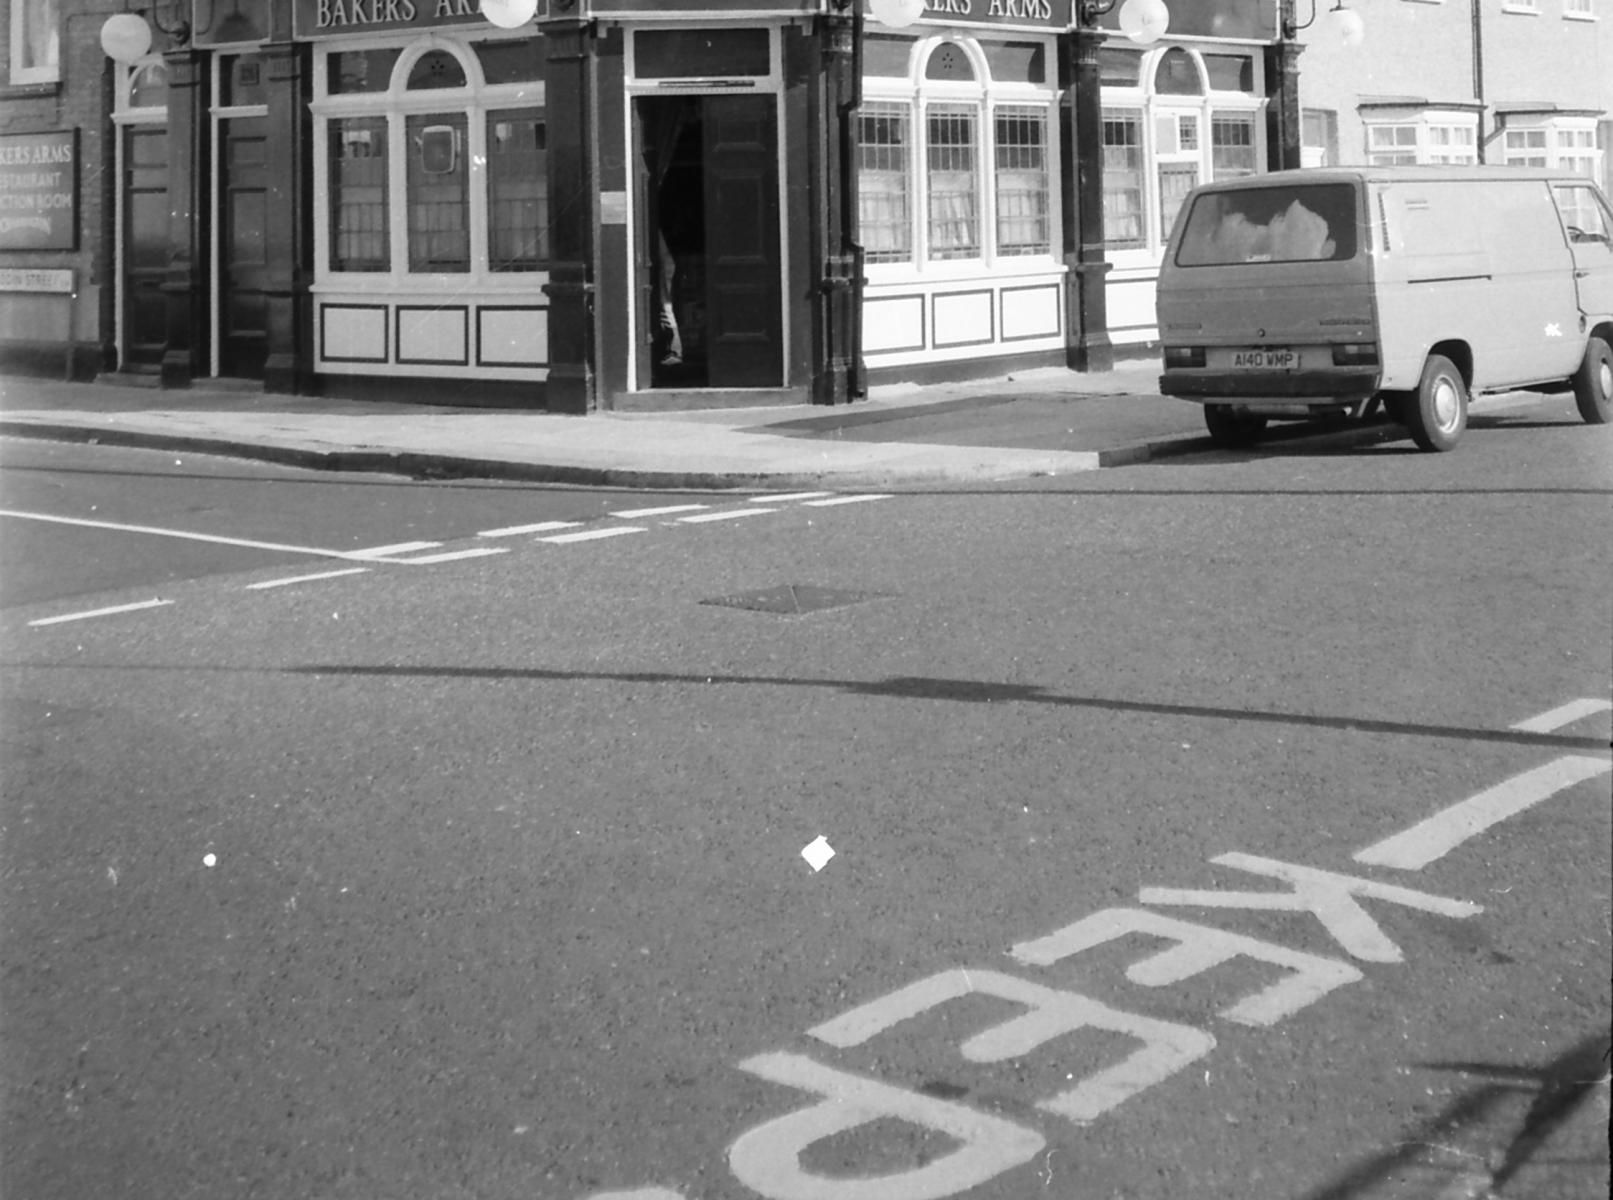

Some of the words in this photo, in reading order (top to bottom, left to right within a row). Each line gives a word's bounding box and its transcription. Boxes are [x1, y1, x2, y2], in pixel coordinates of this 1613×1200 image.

[31, 144, 71, 163] ARMS
[25, 273, 60, 287] STREET
[727, 851, 1485, 1200] KEEP
